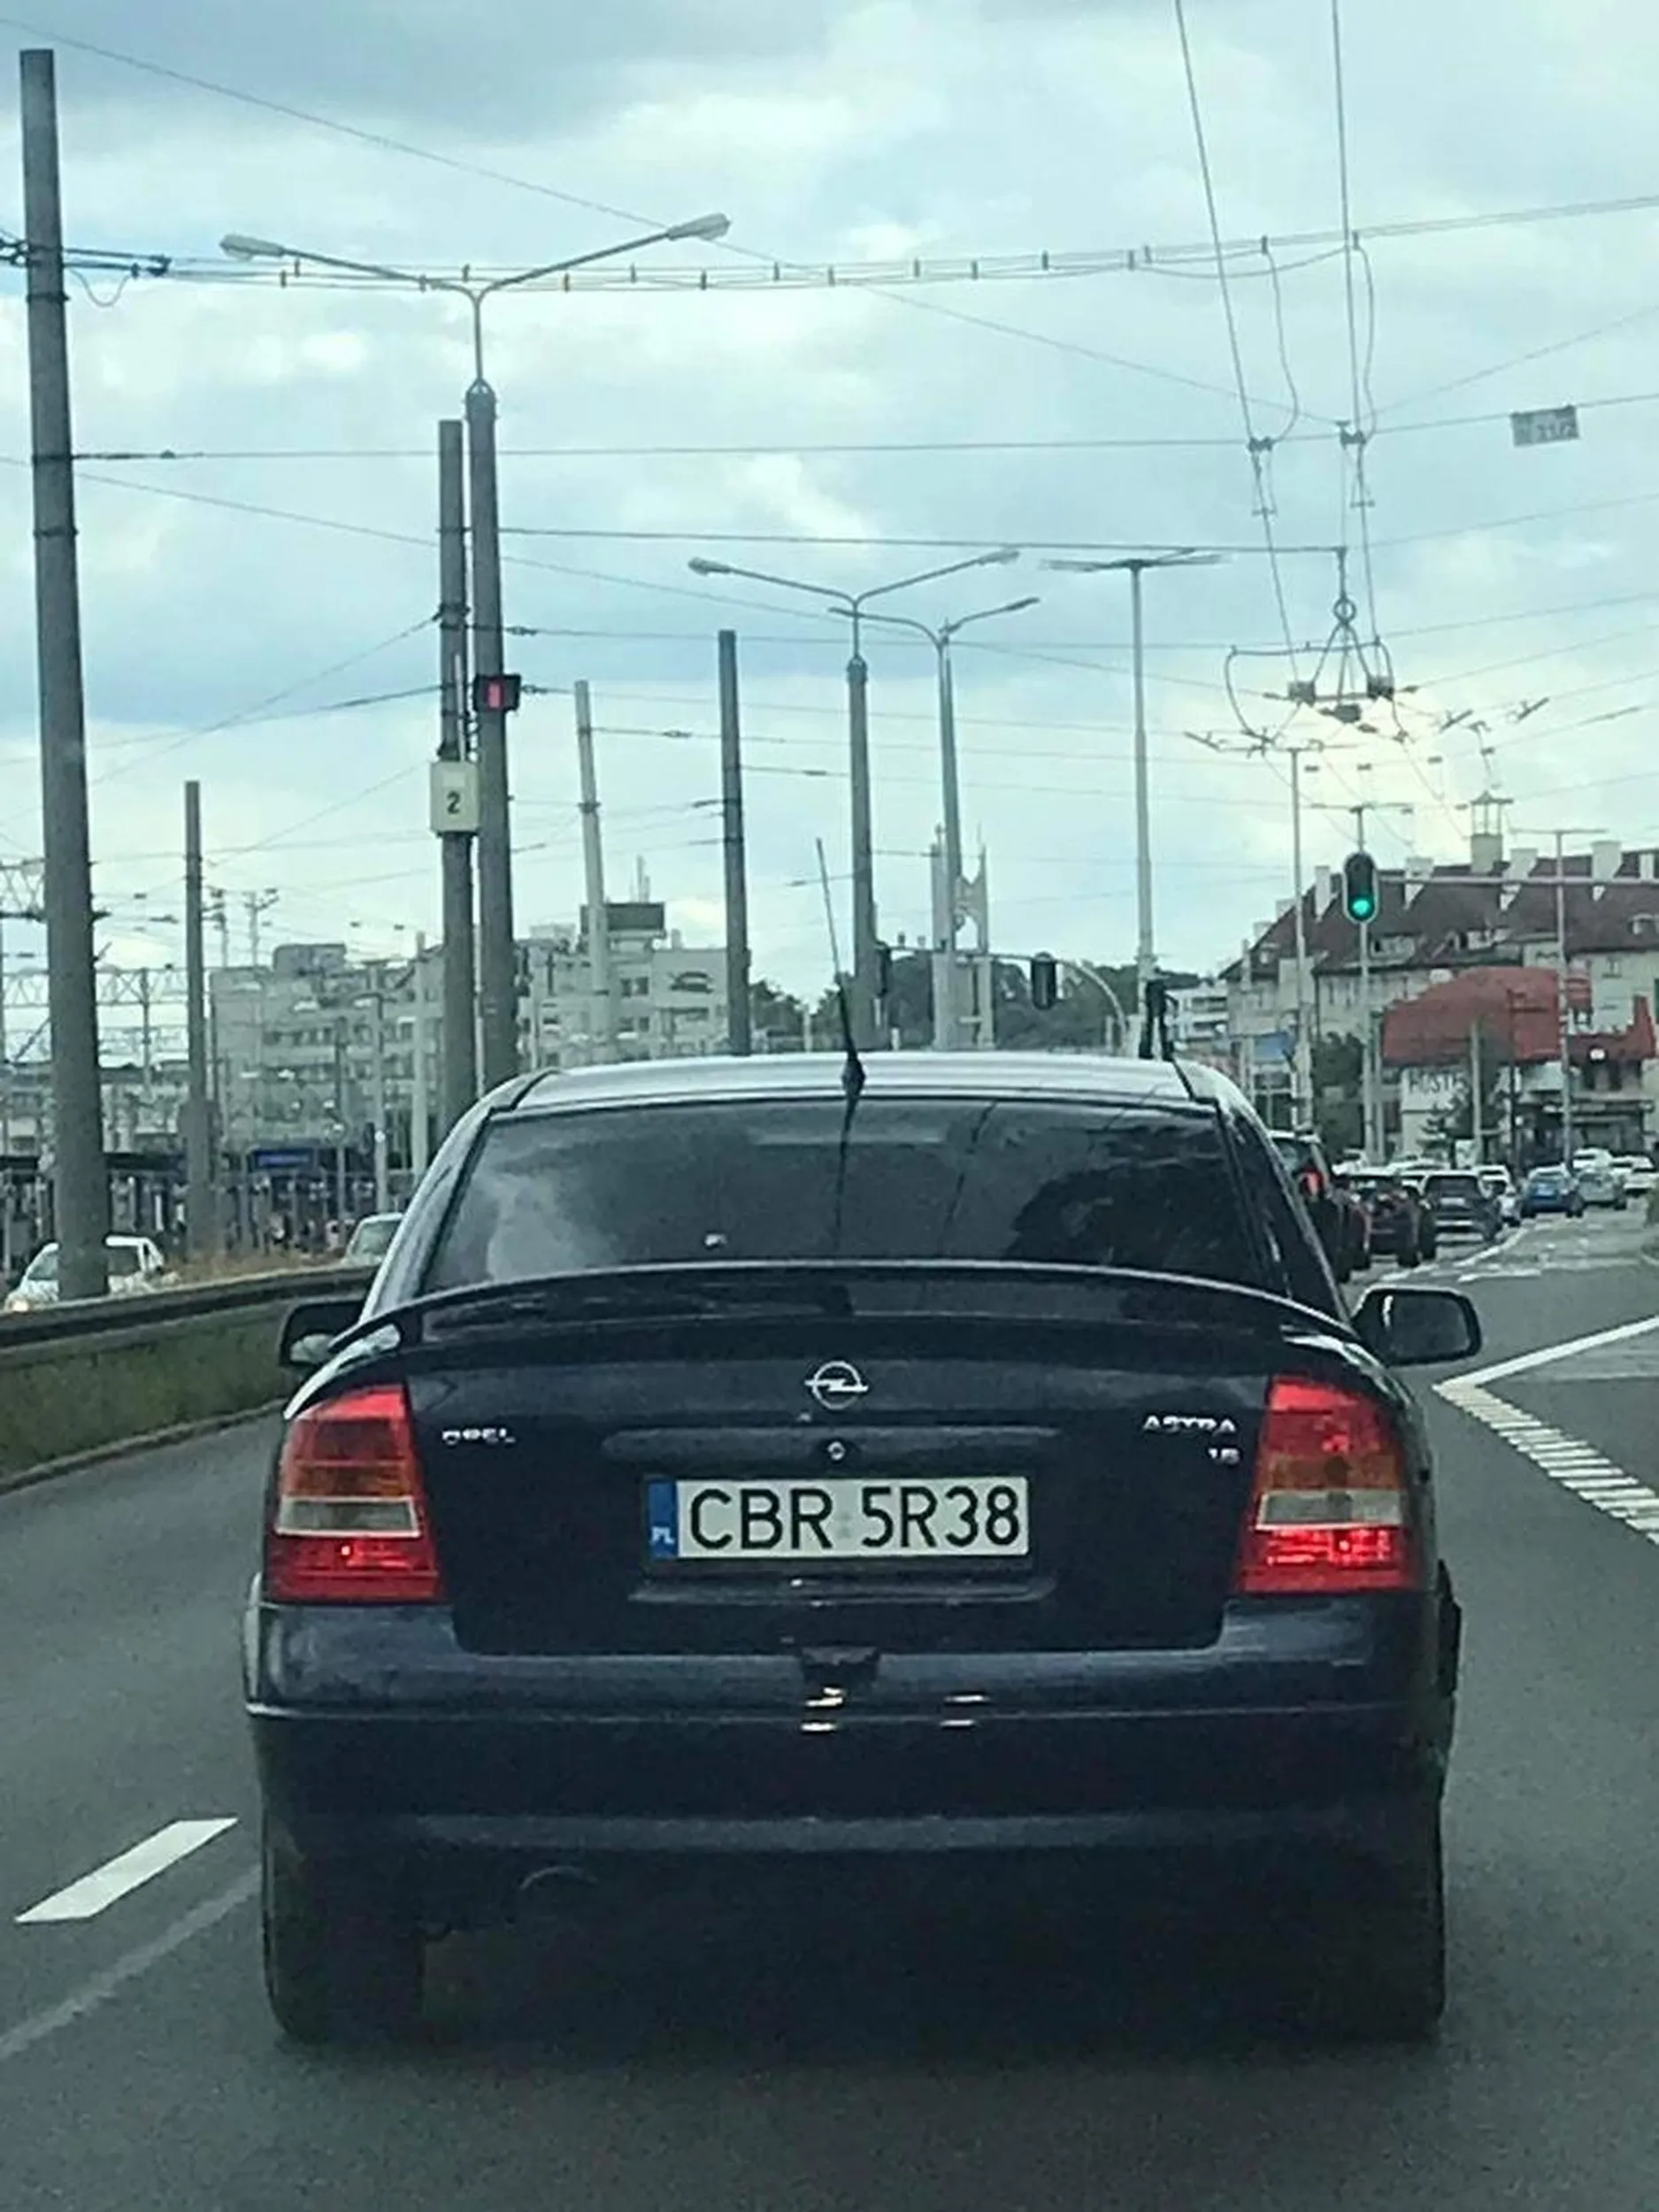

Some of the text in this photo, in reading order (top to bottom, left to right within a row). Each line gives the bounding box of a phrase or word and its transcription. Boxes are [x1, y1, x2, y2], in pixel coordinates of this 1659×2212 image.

[447, 790, 461, 815] 2
[1142, 1414, 1238, 1435] ASTRA
[690, 1486, 1020, 1550] CBR 5R38
[649, 1525, 675, 1545] PL
